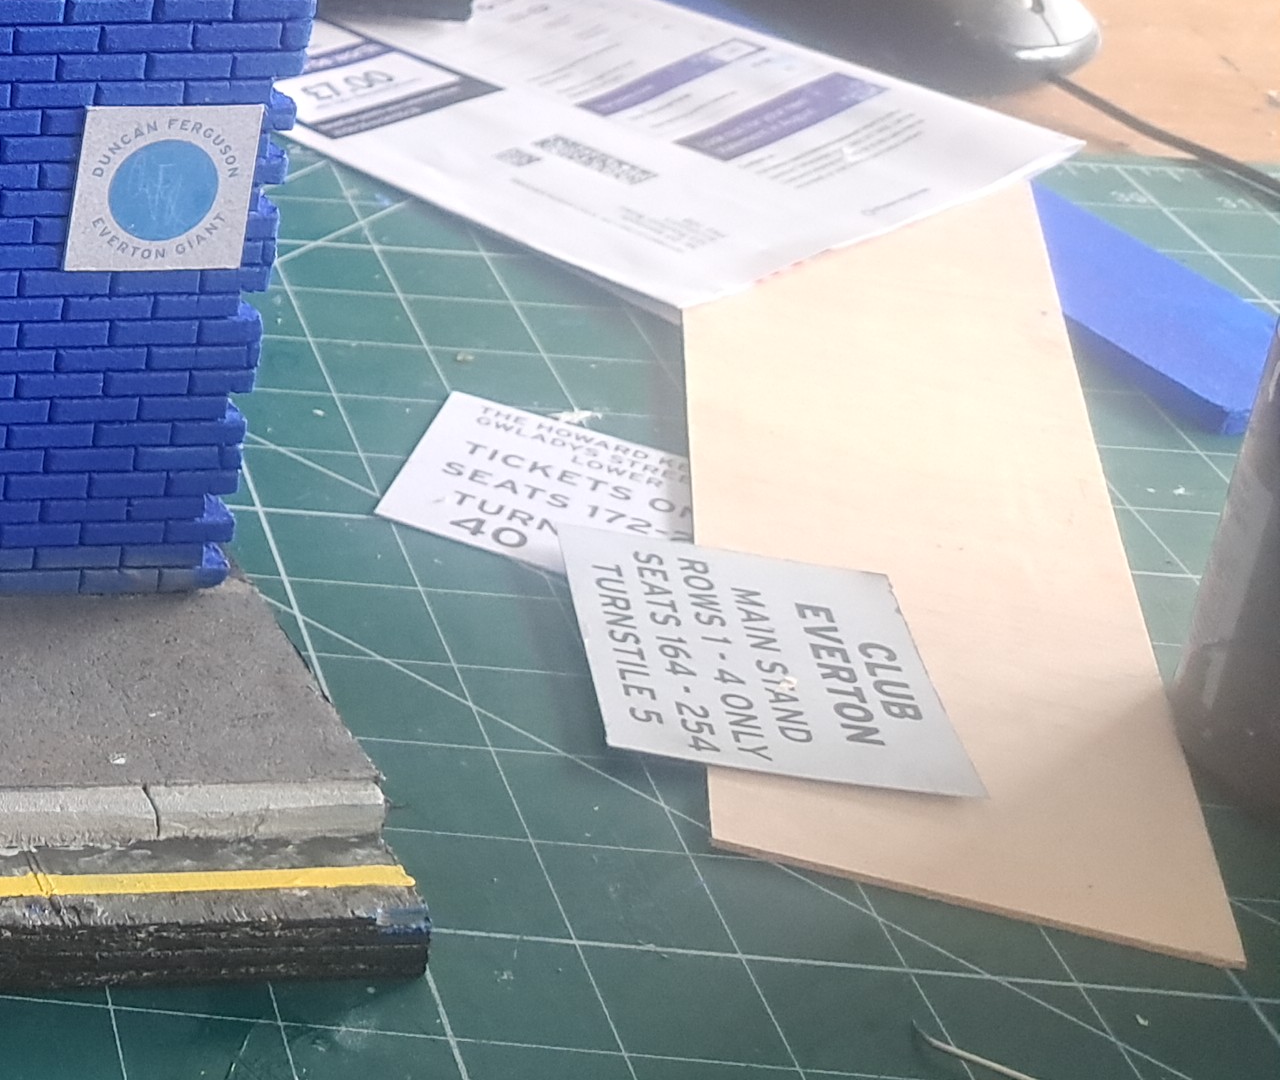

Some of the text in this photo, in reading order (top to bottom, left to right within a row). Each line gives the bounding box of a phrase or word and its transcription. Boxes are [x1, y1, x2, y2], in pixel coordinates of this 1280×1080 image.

[92, 119, 240, 178] DUNCAN FERGUSON
[92, 212, 226, 259] EVERTON GIANT
[476, 416, 599, 457] GWLADYS
[481, 405, 529, 427] THE
[536, 422, 648, 460] HOWARD
[466, 440, 634, 501] TICKETS
[571, 455, 665, 488] LOWER
[442, 461, 693, 542] SEATS 172-
[449, 517, 528, 549] 40
[633, 550, 682, 631] SEATS
[677, 556, 727, 629] ROWS
[731, 587, 782, 653] MAIN
[591, 563, 664, 726] TURNSTILE 5
[655, 636, 698, 678] 164
[794, 602, 886, 747] EVERTON
[714, 667, 746, 687] 4
[858, 641, 923, 722] CLUB
[675, 700, 721, 754] 254
[720, 692, 773, 762] ONLY
